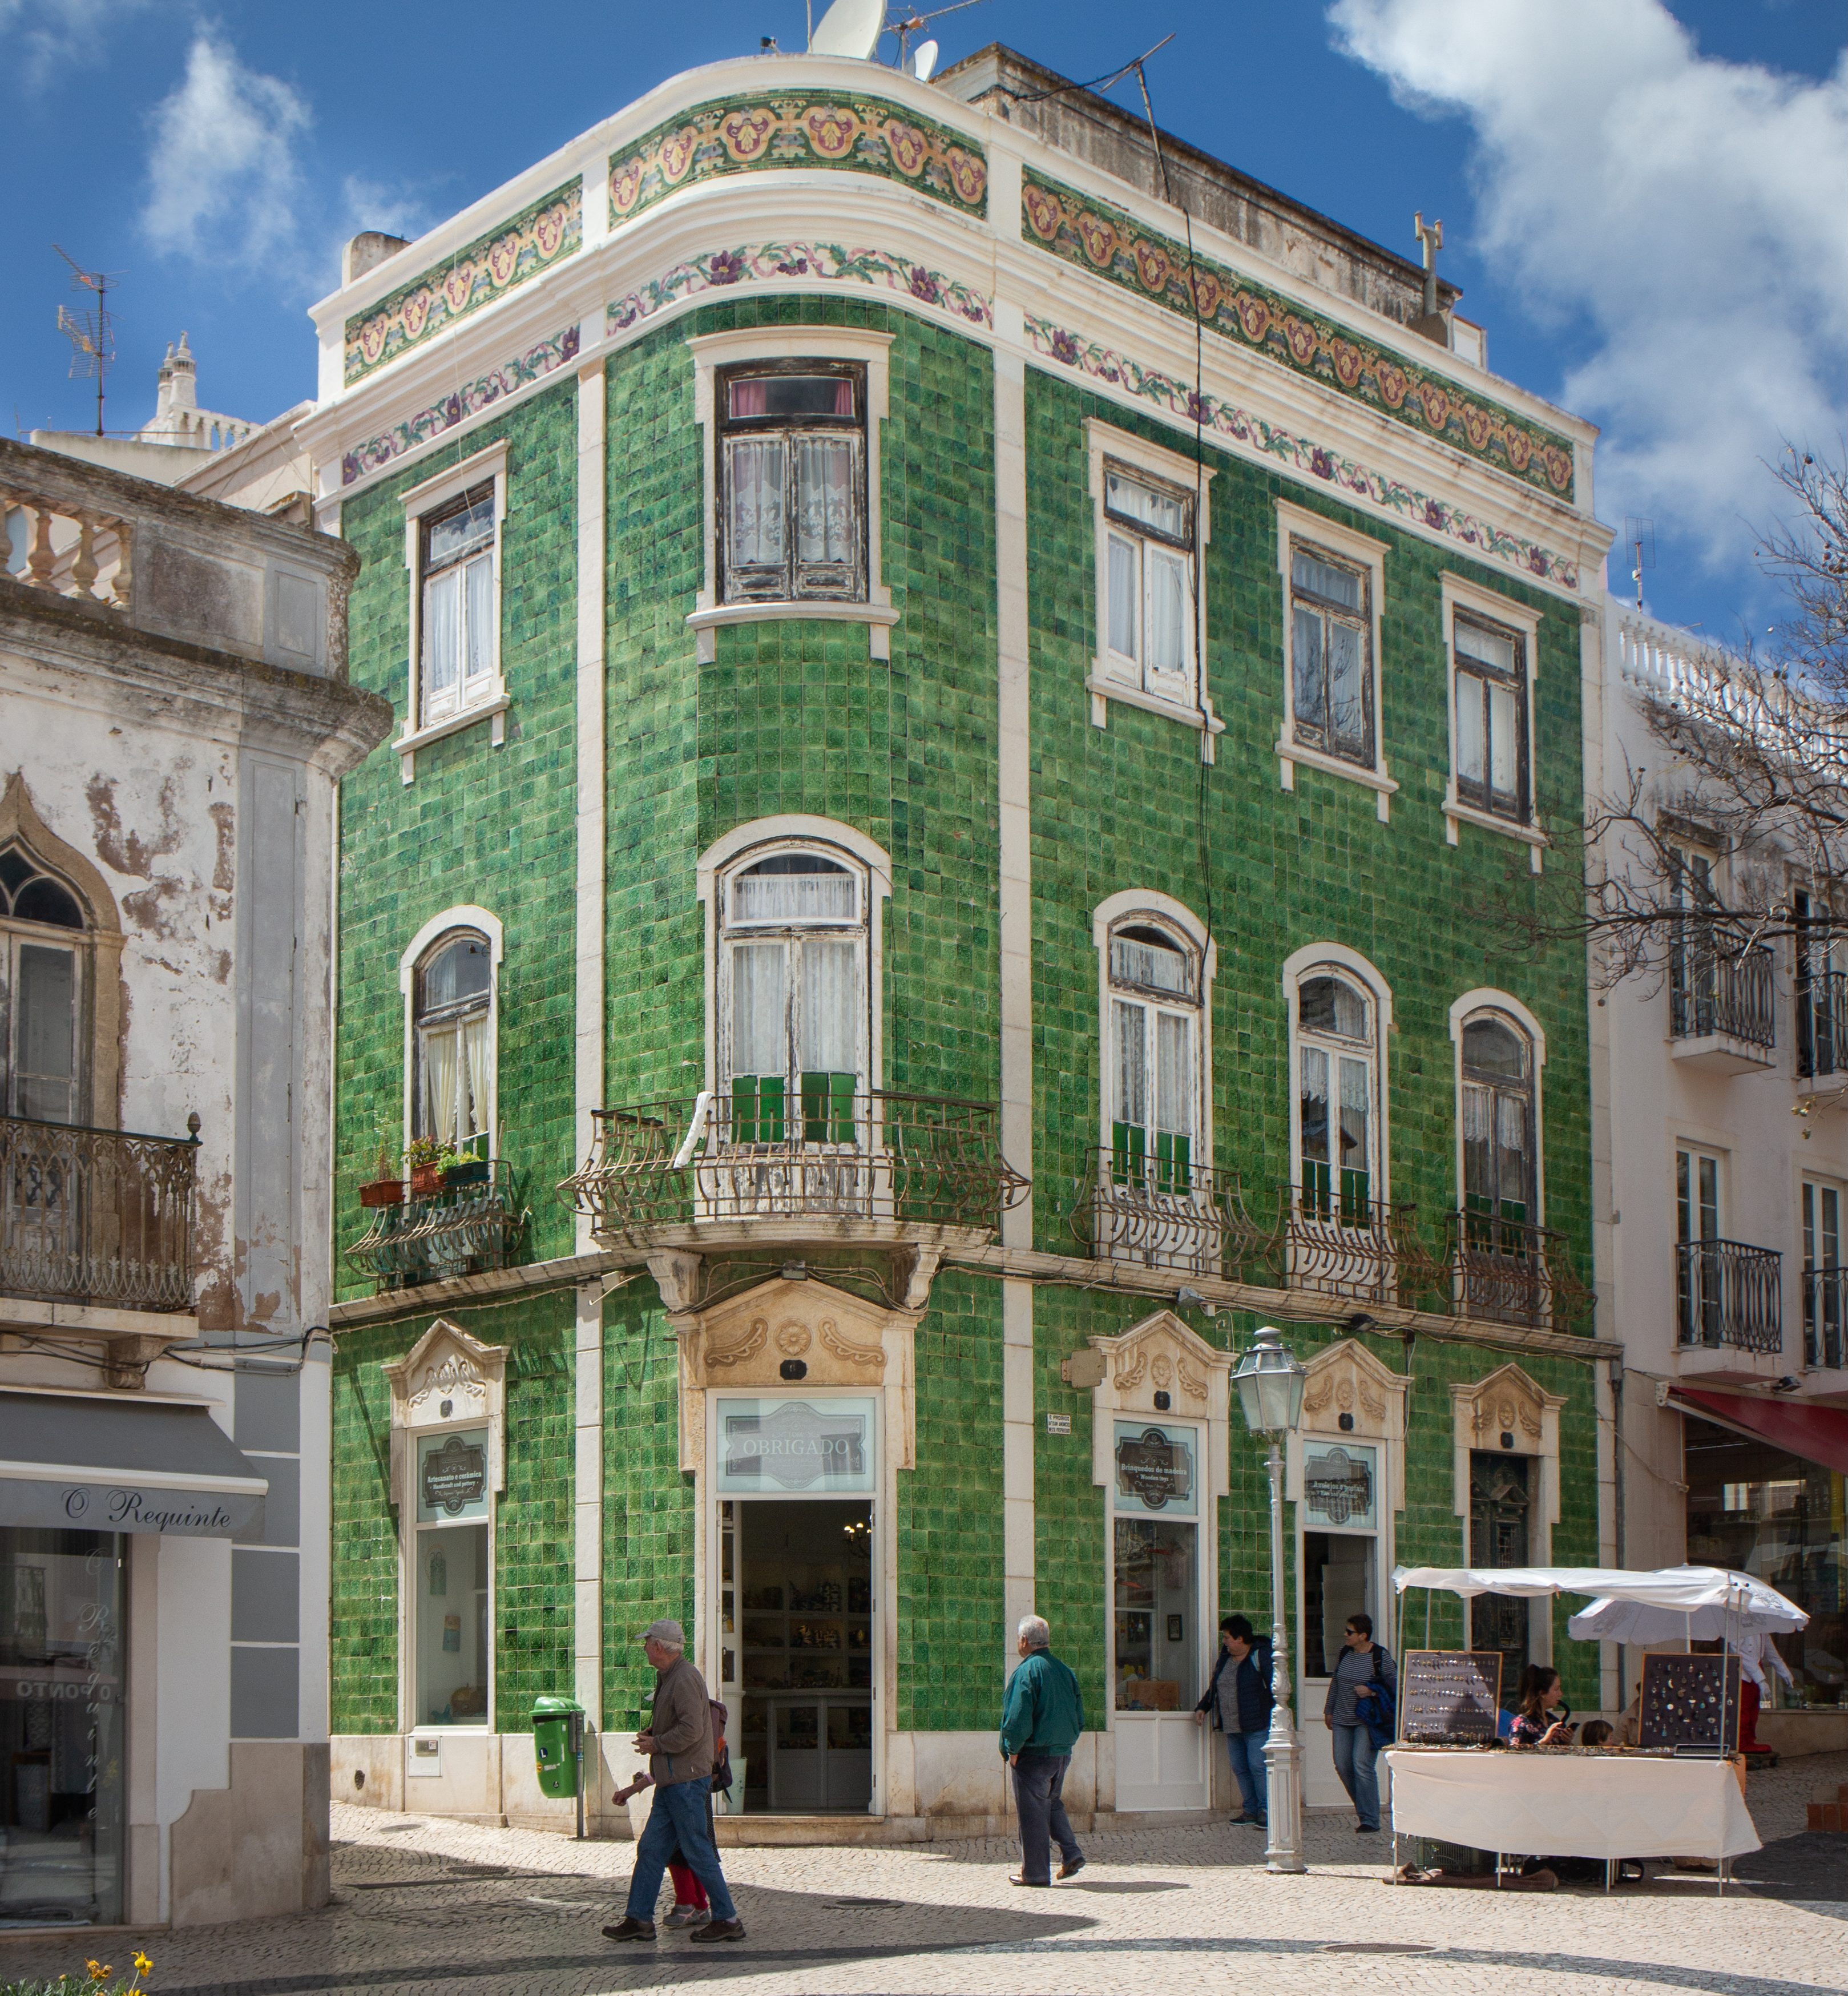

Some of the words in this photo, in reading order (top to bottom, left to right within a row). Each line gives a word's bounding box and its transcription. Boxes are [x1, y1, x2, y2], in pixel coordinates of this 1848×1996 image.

[744, 1439, 848, 1455] OBRIGADO
[1121, 1463, 1155, 1473] Brinquedos
[427, 1474, 454, 1483] Artesanato
[459, 1471, 482, 1479] cerâmica
[61, 1487, 90, 1518] O
[106, 1489, 231, 1532] Requinte
